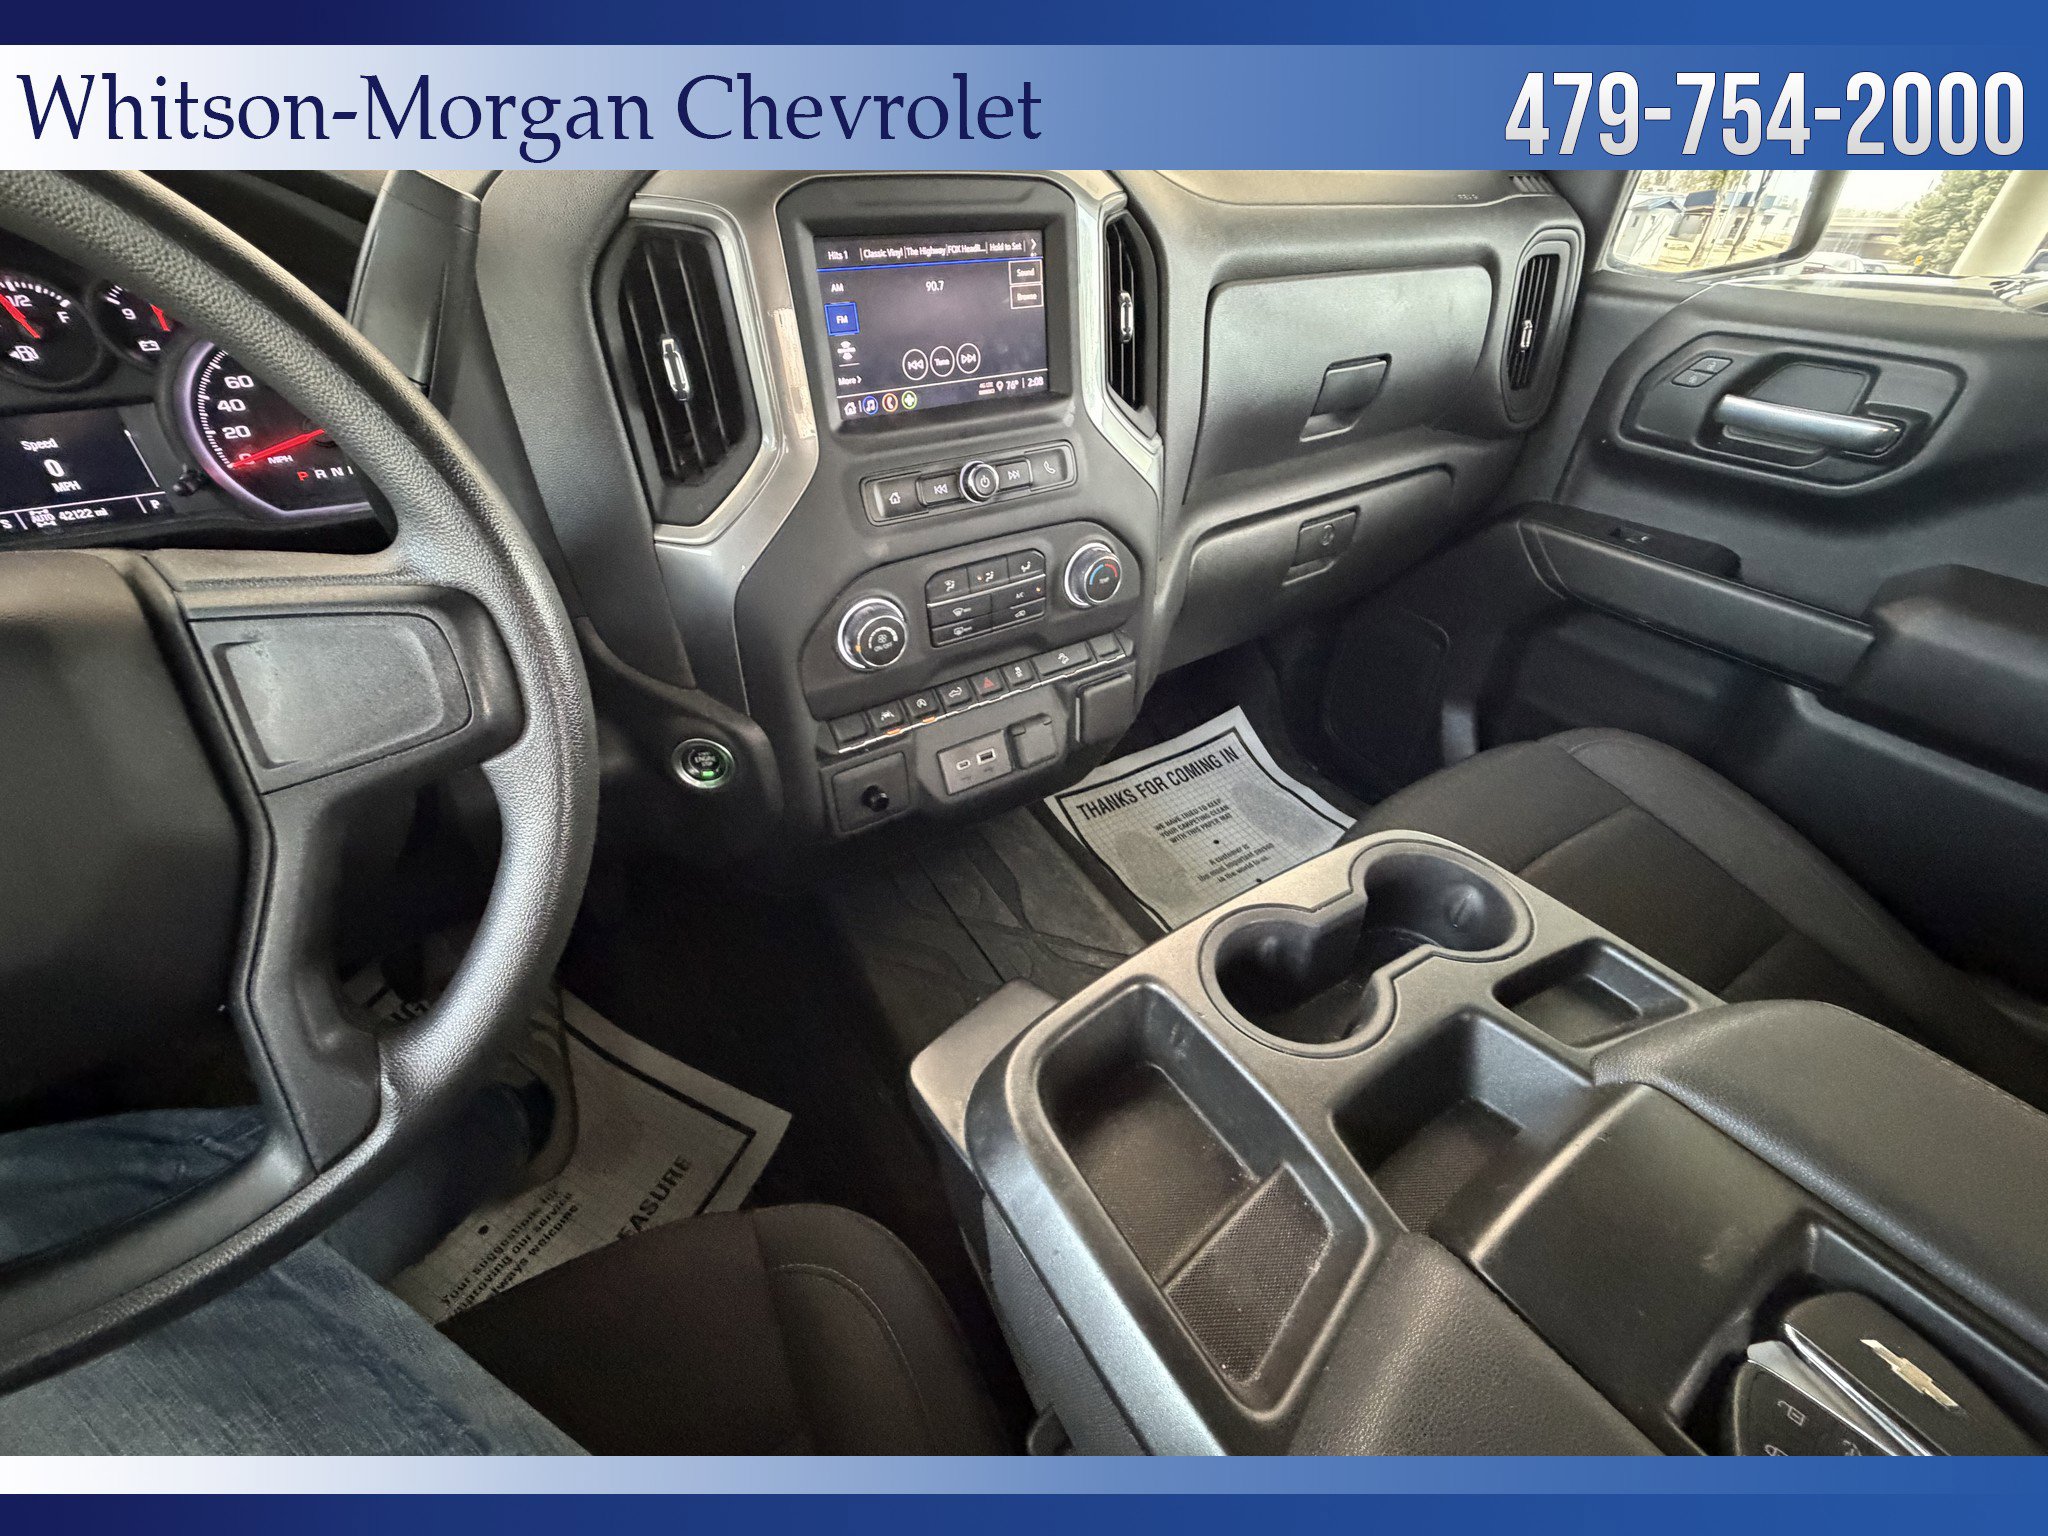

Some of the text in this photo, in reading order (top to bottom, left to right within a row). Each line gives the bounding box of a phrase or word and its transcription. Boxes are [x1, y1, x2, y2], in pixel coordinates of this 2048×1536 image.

[906, 245, 946, 258] The Highway
[947, 245, 961, 254] FOX
[989, 241, 1023, 251] Hold to Set
[827, 250, 843, 260] Hits
[863, 246, 904, 261] Classic Vinyl
[831, 283, 844, 293] AM
[925, 280, 945, 292] 90.7
[56, 311, 70, 324] F
[121, 307, 138, 321] 9
[836, 315, 849, 324] FM
[224, 375, 255, 390] 60
[837, 377, 857, 386] More
[216, 398, 247, 413] 40
[221, 425, 252, 440] 20
[20, 437, 59, 453] Speed
[267, 454, 294, 465] MPH
[43, 458, 66, 478] 0
[296, 471, 309, 481] P
[313, 468, 328, 480] R
[330, 466, 345, 478] N
[51, 480, 82, 493] MPH
[149, 499, 161, 510] P
[58, 507, 109, 521] 42122 mi
[1076, 745, 1240, 820] THANKS FOR COMING IN
[1160, 804, 1230, 838] YOUR CARPETING CLEAN
[1164, 816, 1181, 827] HAVE
[1169, 811, 1233, 844] WITH THIS PAPER MAT
[440, 1277, 471, 1306] Your
[472, 1206, 542, 1275] suggestions
[453, 1255, 512, 1314] mproving
[511, 1234, 531, 1254] our
[490, 1257, 528, 1292] lways
